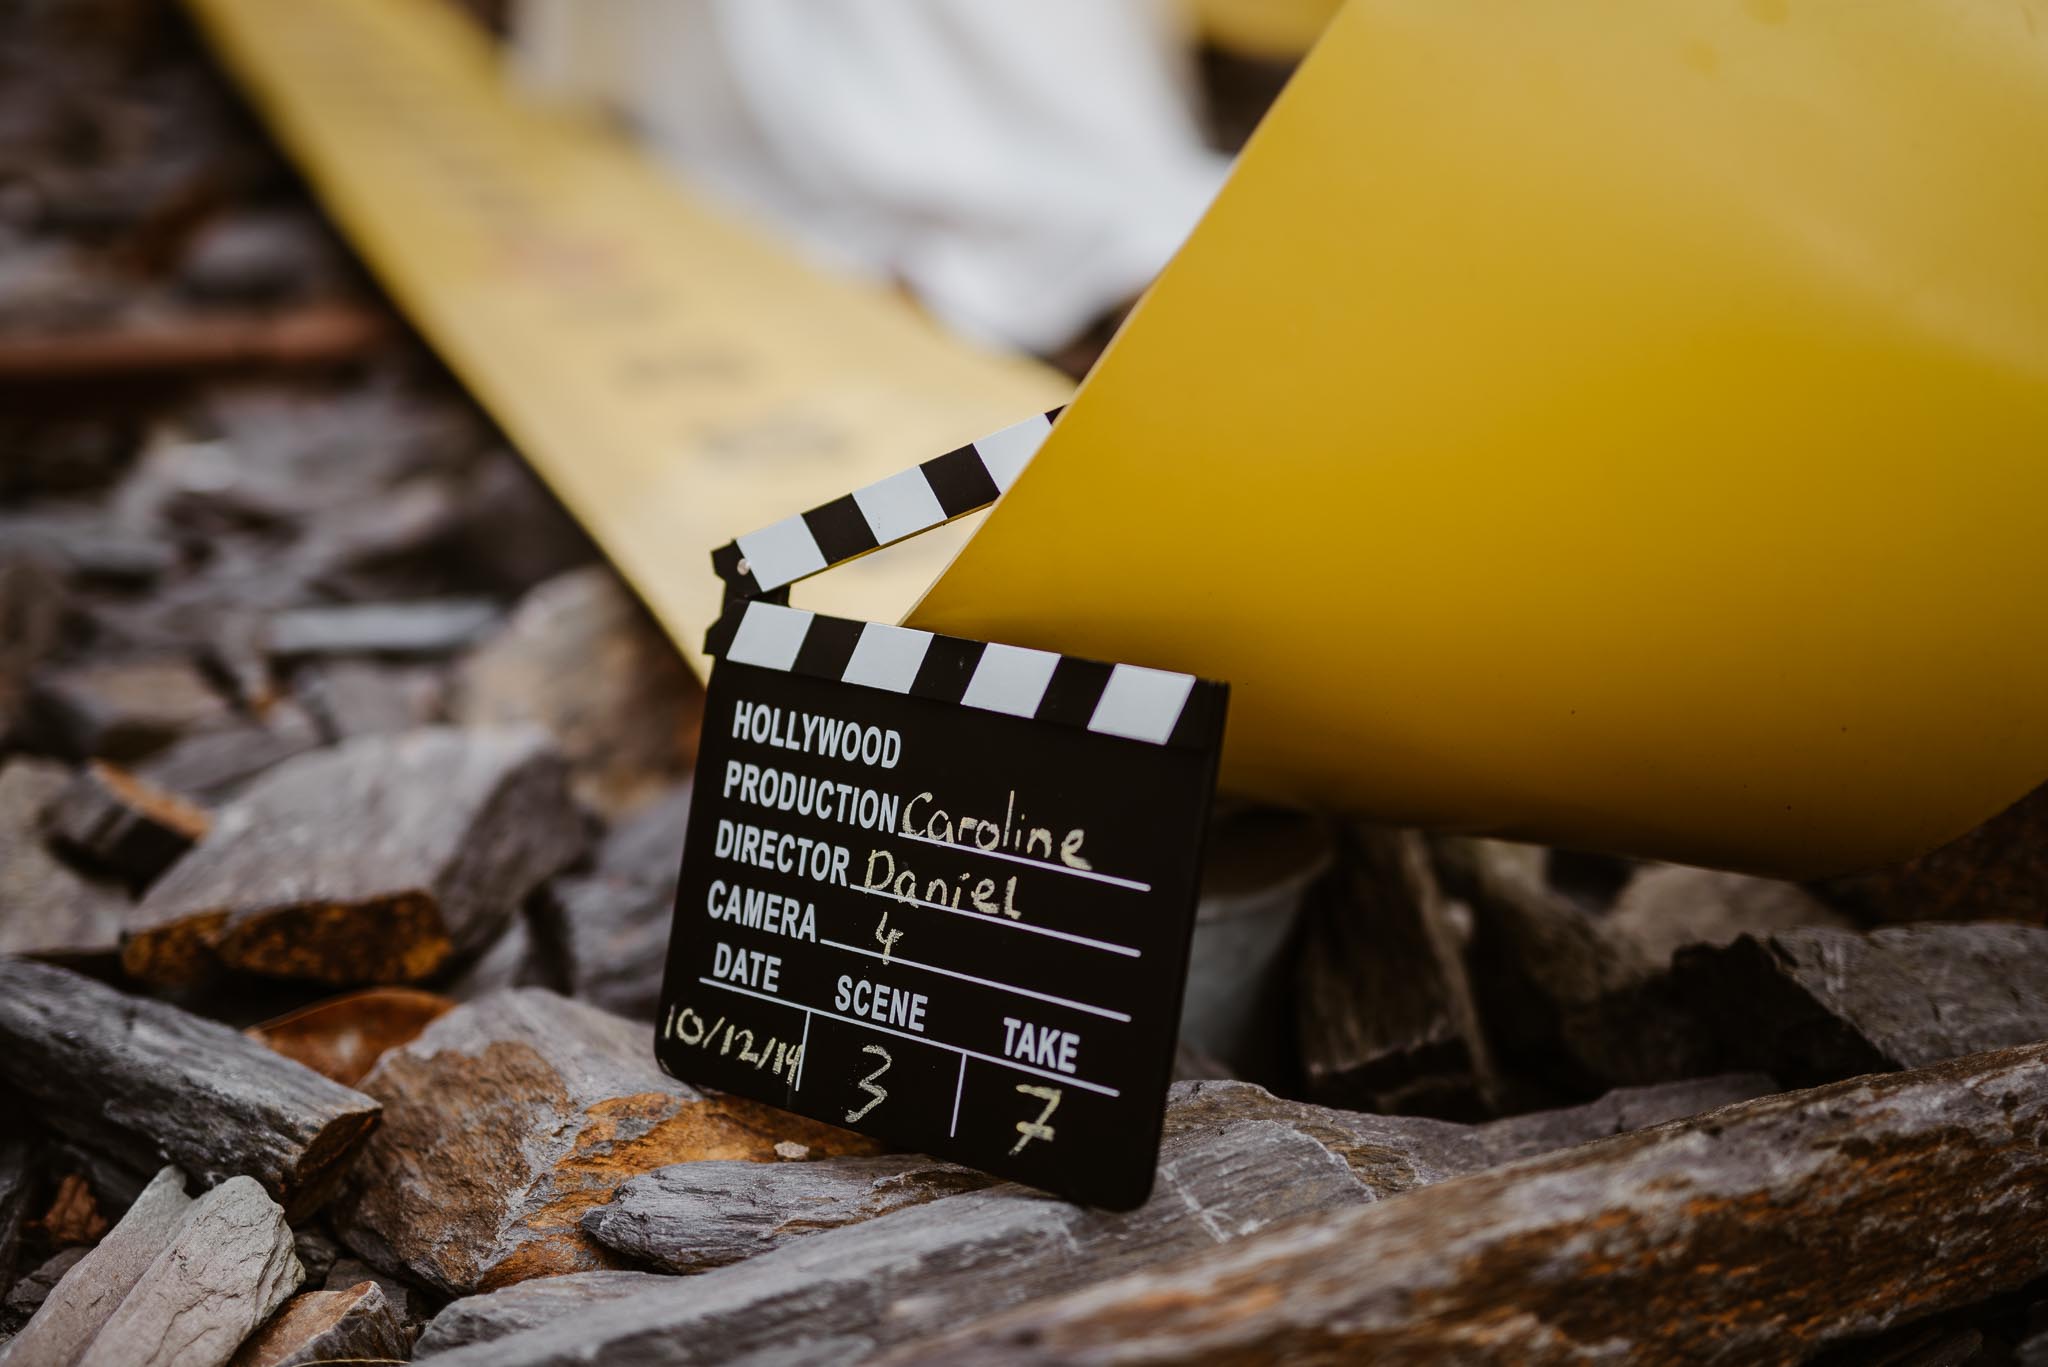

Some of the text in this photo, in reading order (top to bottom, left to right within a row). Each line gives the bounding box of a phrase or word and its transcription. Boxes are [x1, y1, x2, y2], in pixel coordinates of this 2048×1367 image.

[732, 700, 901, 769] HOLLYWOOD
[723, 760, 899, 833] PRODUCTION
[901, 790, 1092, 871] Caroline
[715, 818, 850, 887] DIRECTOR
[864, 848, 1022, 919] Daniel
[706, 879, 817, 942] CAMERA
[875, 911, 904, 965] 4
[712, 942, 782, 993] DATE
[834, 974, 928, 1032] SCENE
[1003, 1017, 1080, 1074] TAKE
[844, 1044, 893, 1124] 3
[1008, 1083, 1062, 1156] 7
